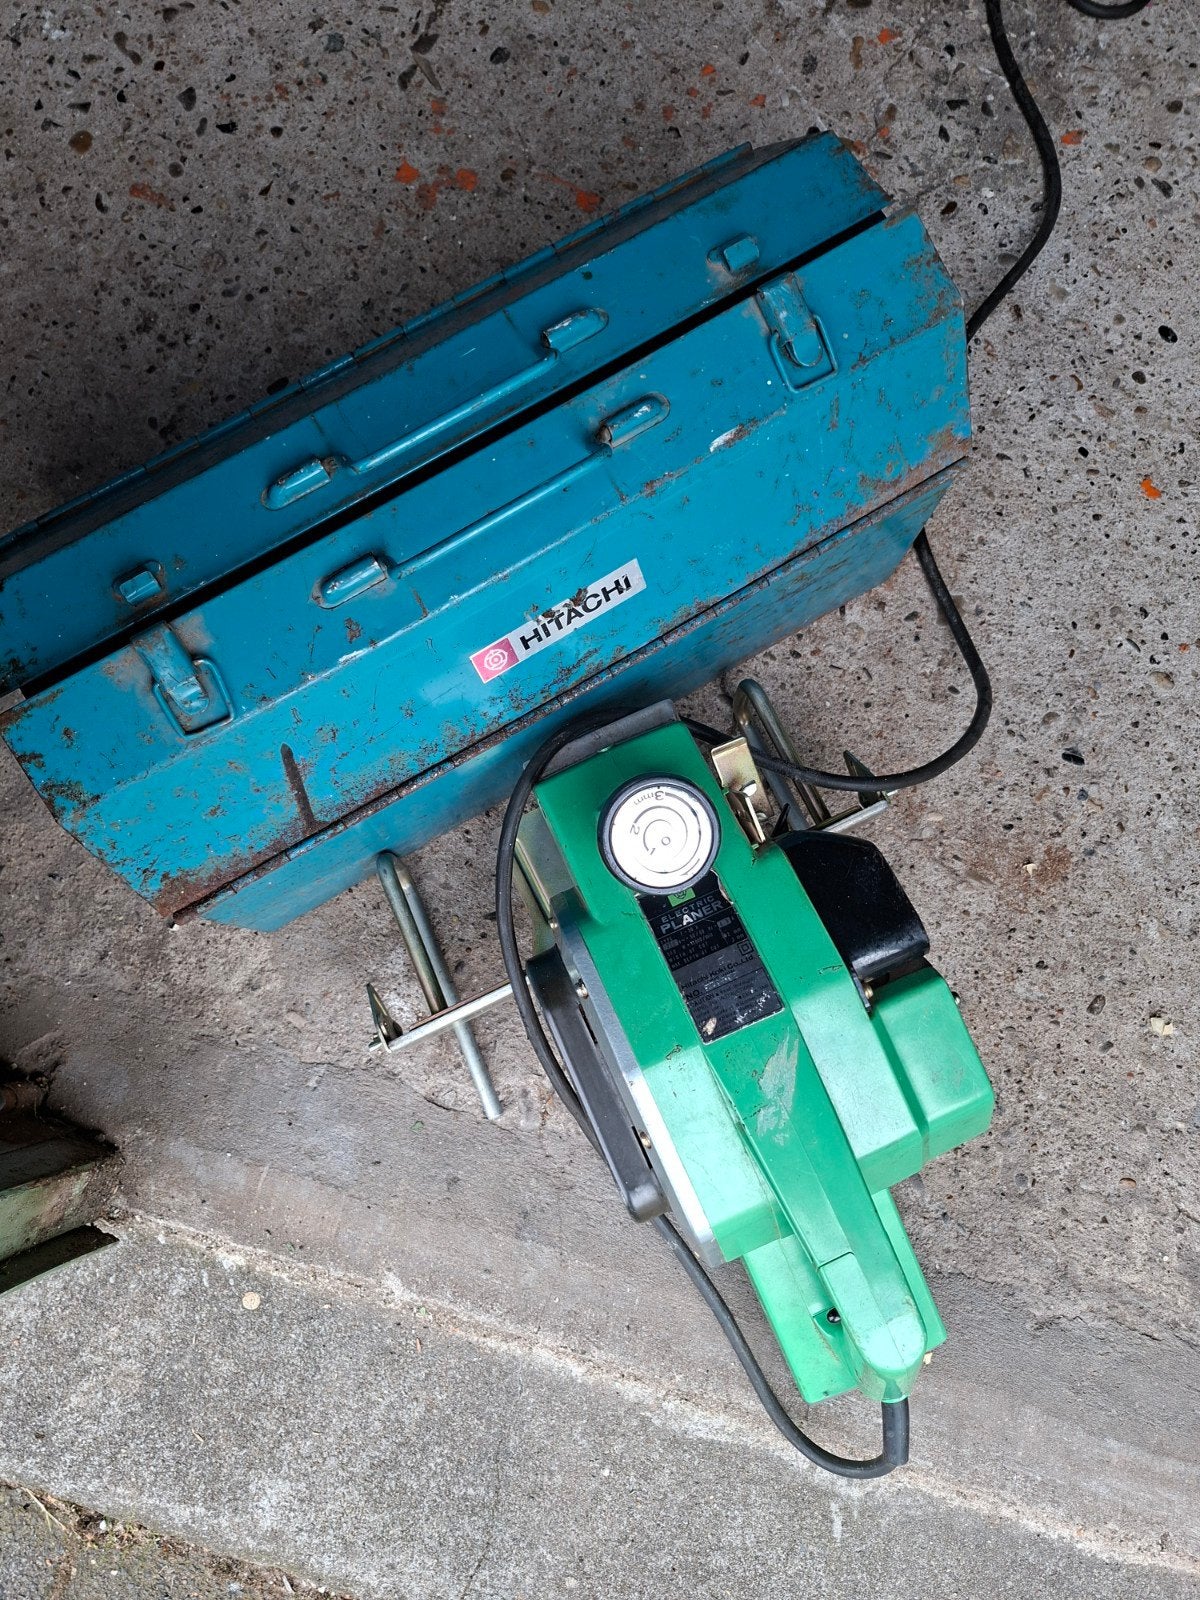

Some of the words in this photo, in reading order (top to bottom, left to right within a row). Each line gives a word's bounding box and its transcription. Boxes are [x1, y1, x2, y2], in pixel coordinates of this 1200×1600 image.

[519, 574, 632, 650] HITACHI
[629, 824, 640, 835] 2
[660, 899, 724, 935] PLANER
[661, 895, 715, 924] ELECTRIC
[709, 965, 727, 979] Koki
